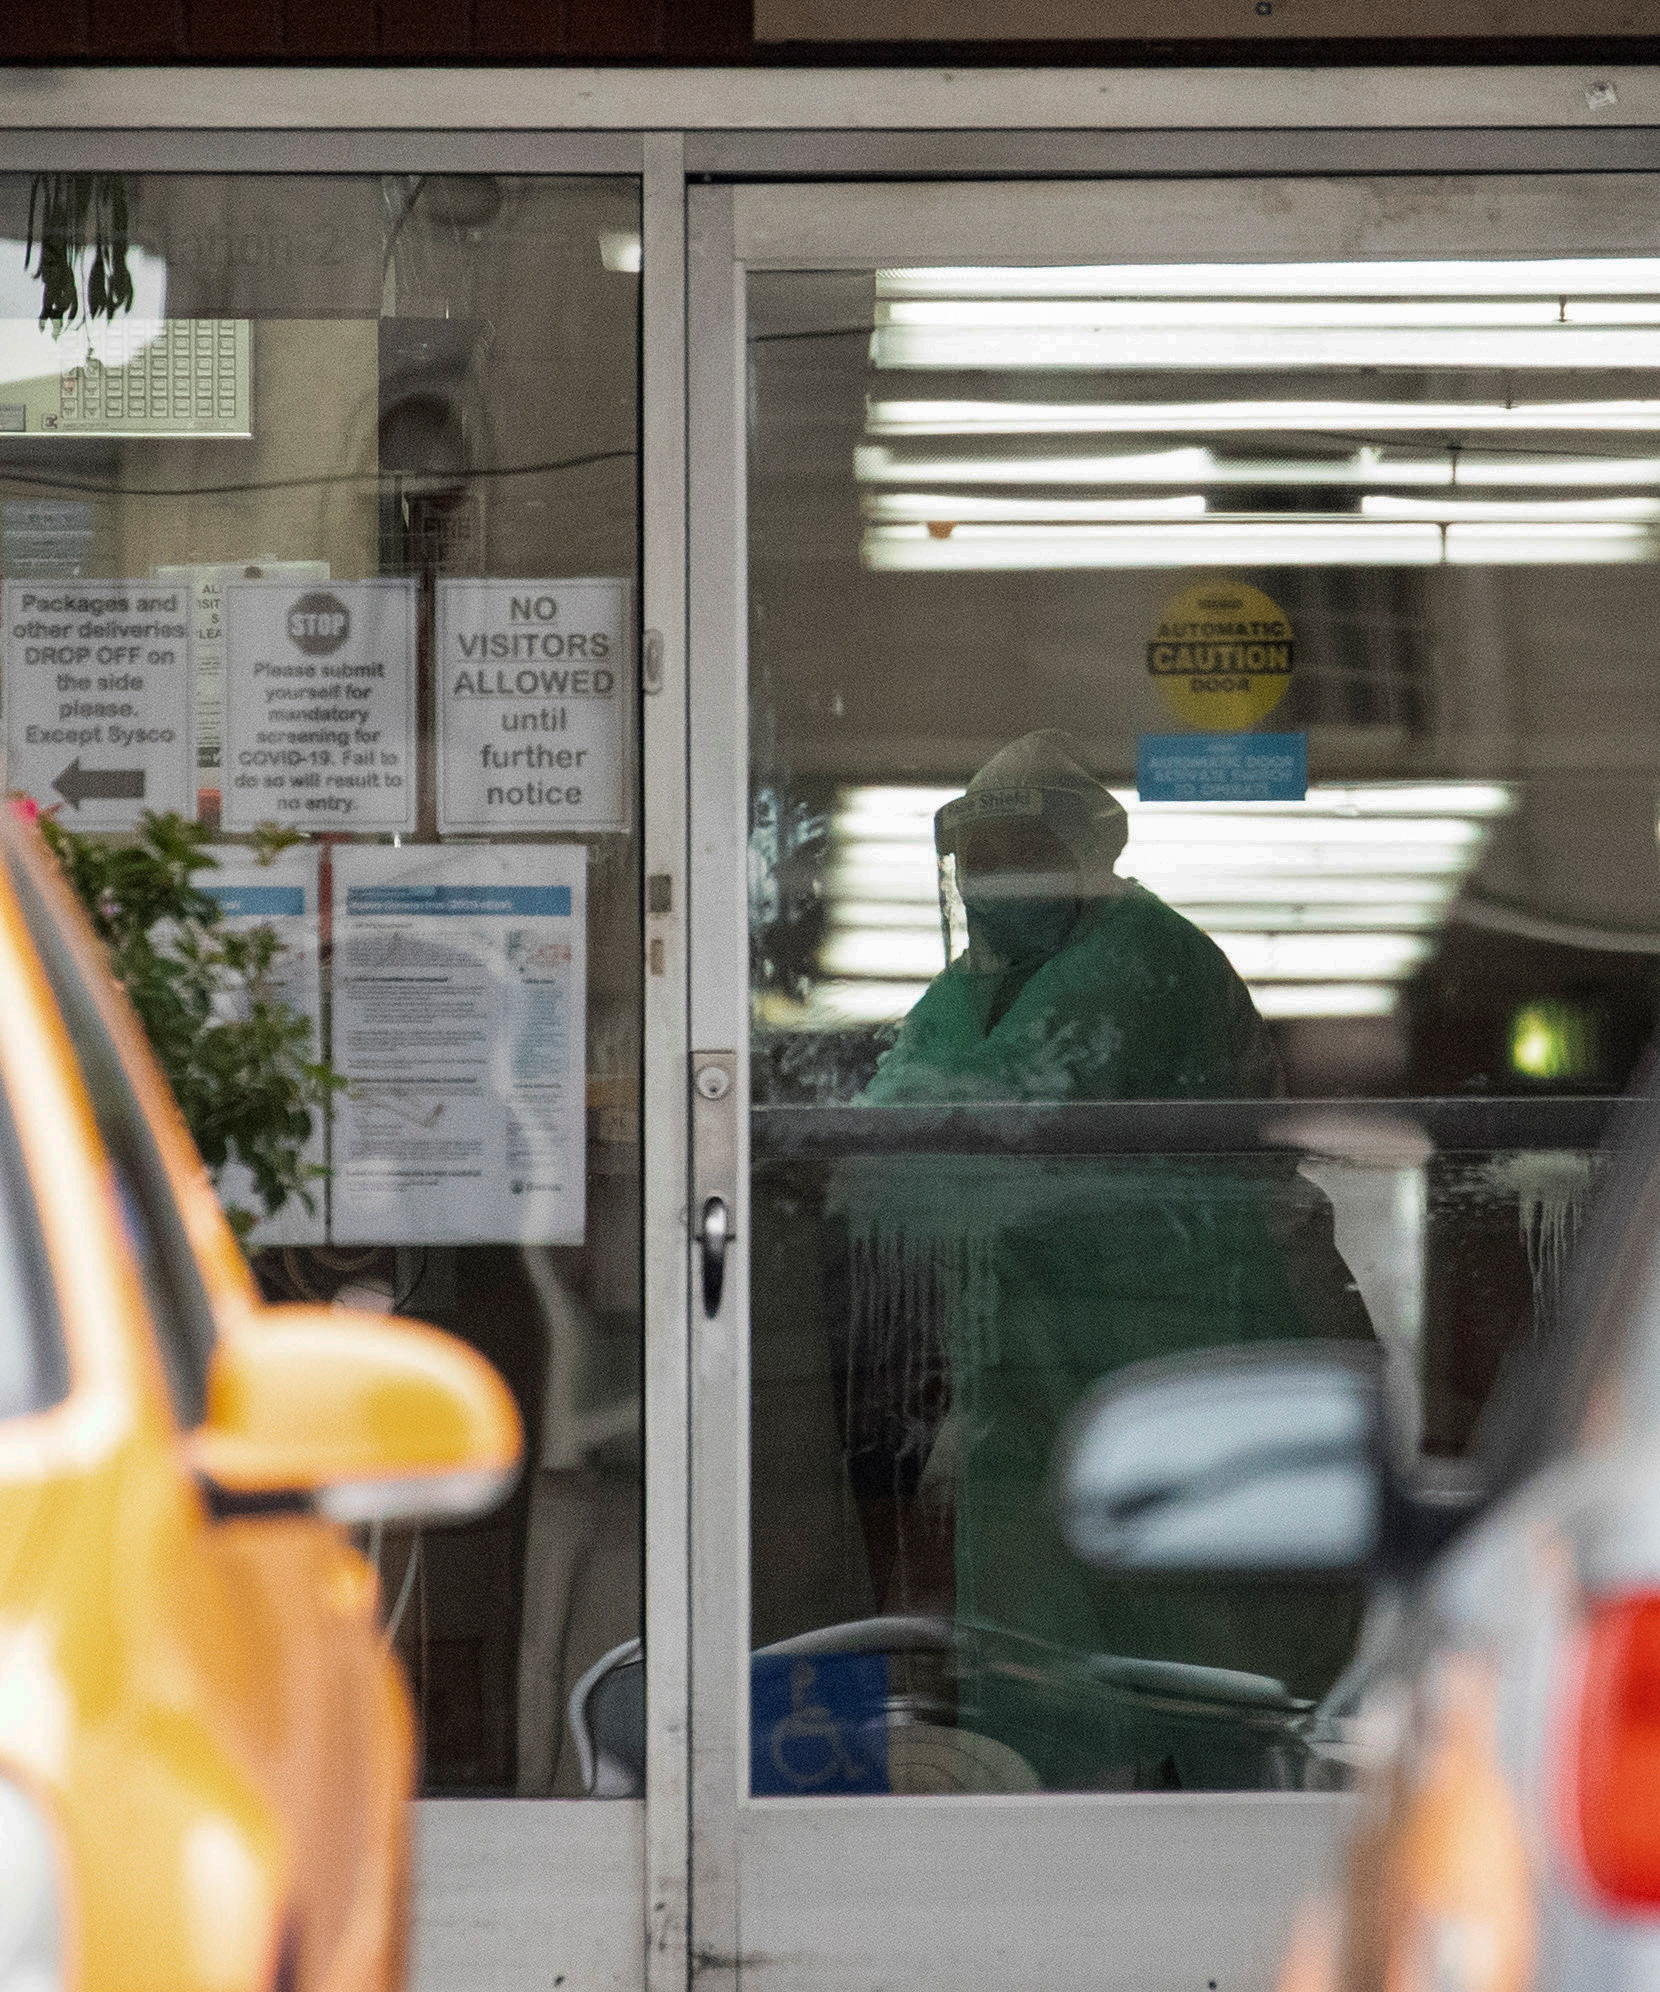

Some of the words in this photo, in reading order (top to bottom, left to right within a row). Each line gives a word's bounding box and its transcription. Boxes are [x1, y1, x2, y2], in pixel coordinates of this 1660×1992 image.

[22, 594, 129, 615] Packages
[136, 594, 178, 612] and
[510, 596, 557, 621] NO
[12, 621, 72, 639] other
[78, 621, 187, 639] deliveries
[290, 613, 346, 637] STOP
[1158, 621, 1286, 637] AUTOMATIC
[457, 633, 610, 658] VISITORS
[24, 647, 91, 666] DROP
[96, 647, 142, 666] OFF
[148, 650, 175, 665] on
[1153, 646, 1288, 671] CAUTION
[254, 662, 316, 678] Please
[321, 662, 385, 678] submit
[56, 673, 91, 691] the
[98, 673, 143, 691] side
[453, 669, 614, 695] ALLOWED
[1190, 678, 1251, 692] DOOR
[265, 684, 341, 703] yourself
[345, 684, 372, 699] for
[59, 701, 138, 721] please.
[268, 707, 369, 725] mandatory
[502, 706, 567, 732] until
[25, 724, 101, 747] Except
[107, 724, 176, 747] Sysco
[255, 730, 349, 747] screening
[354, 730, 380, 744] for
[342, 751, 375, 766] Fail
[380, 751, 397, 766] to
[480, 743, 588, 769] further
[234, 774, 258, 789] do
[263, 776, 285, 789] so
[290, 774, 321, 789] will
[326, 774, 379, 789] result
[384, 774, 402, 789] to
[487, 782, 583, 805] notice
[277, 797, 300, 811] no
